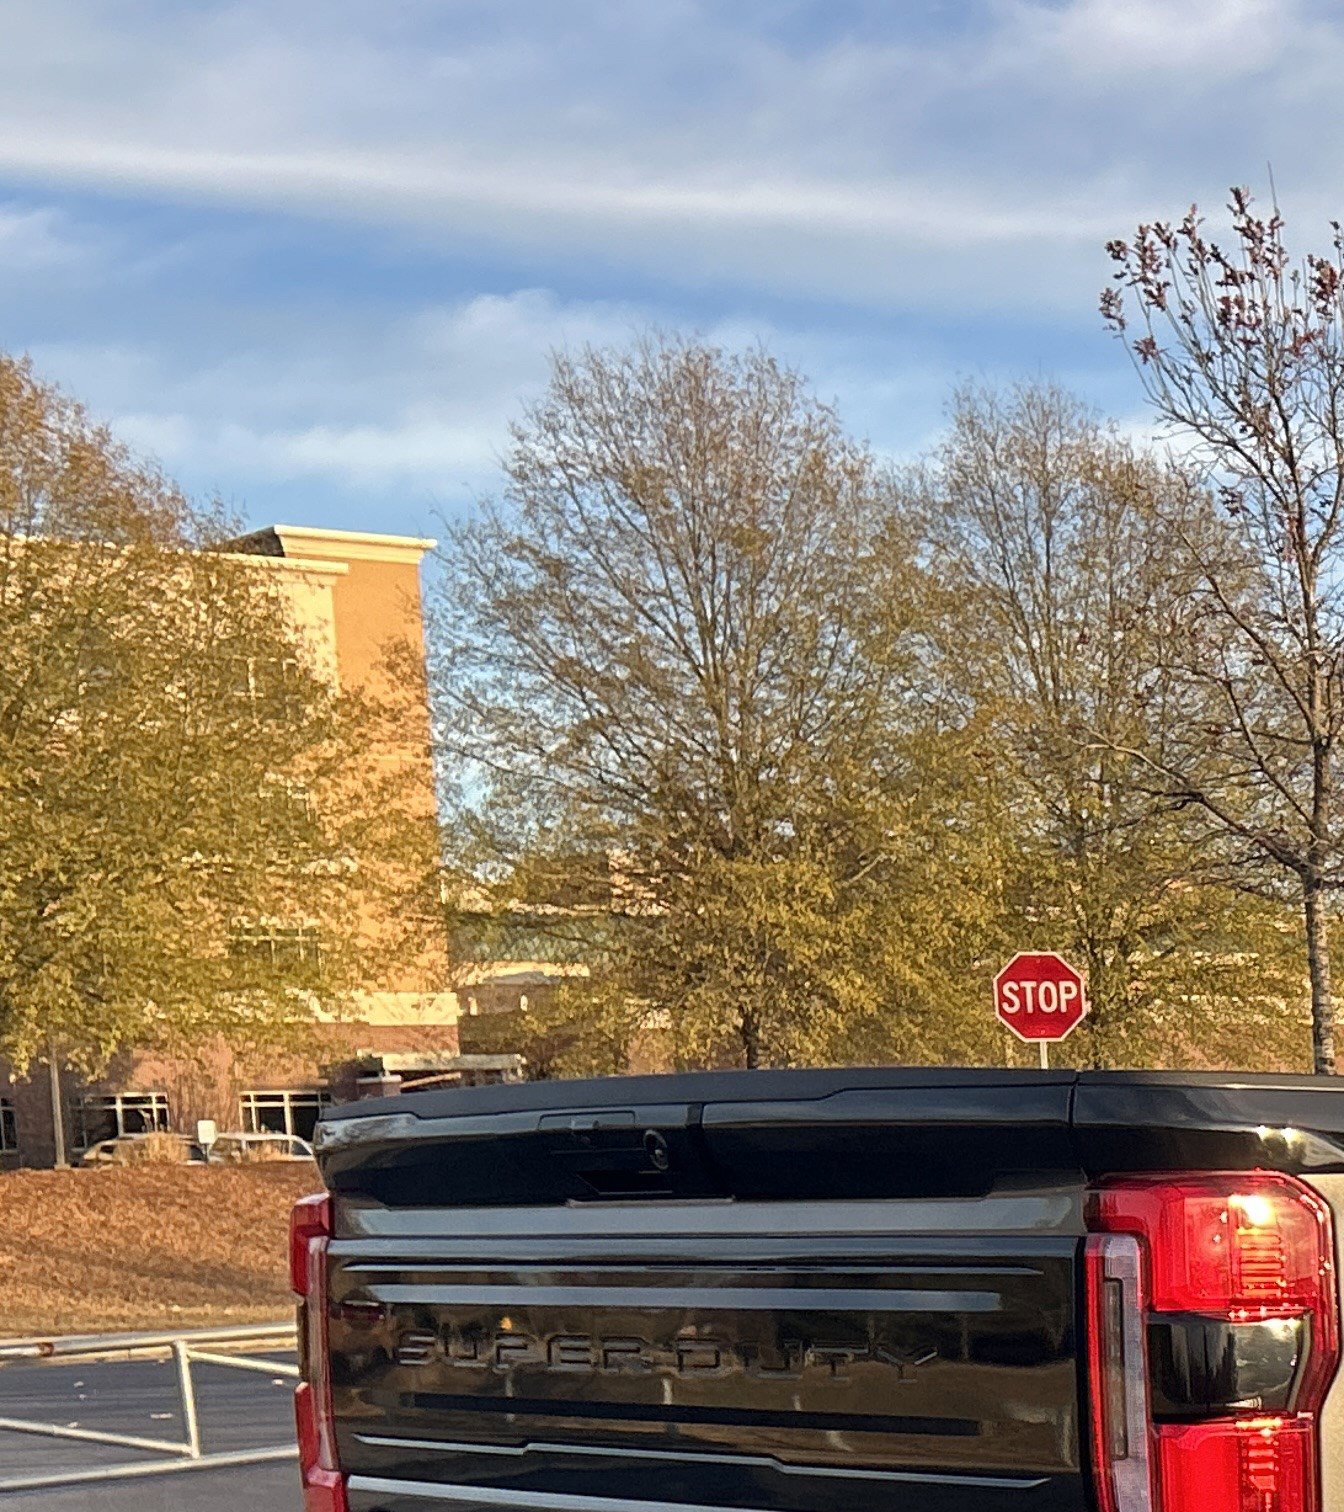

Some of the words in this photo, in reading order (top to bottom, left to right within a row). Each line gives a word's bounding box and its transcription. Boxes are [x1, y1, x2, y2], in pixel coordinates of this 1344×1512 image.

[1002, 981, 1078, 1014] STOP
[394, 1328, 653, 1375] SUPER
[674, 1335, 938, 1384] DUTY
